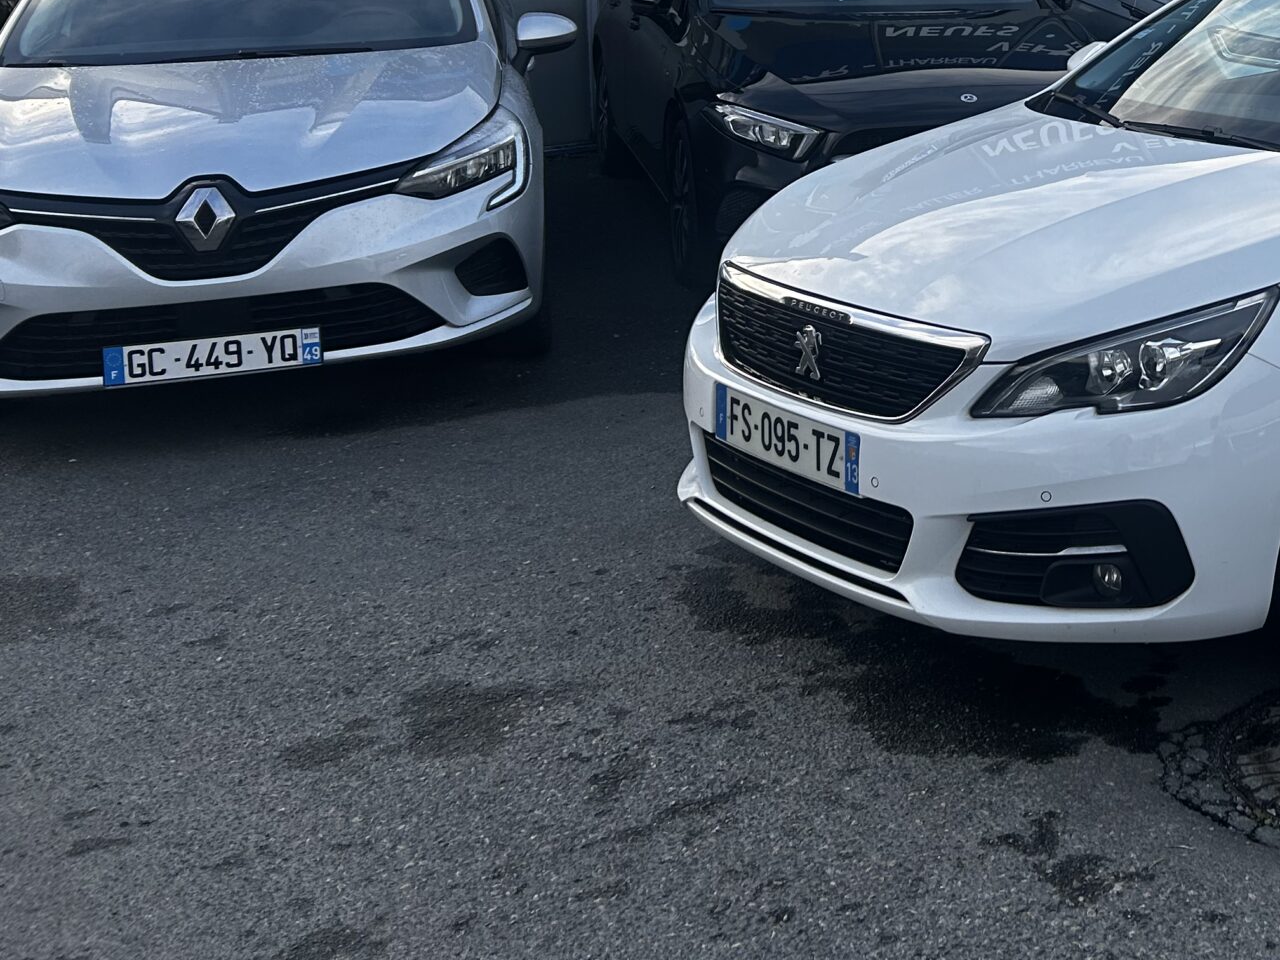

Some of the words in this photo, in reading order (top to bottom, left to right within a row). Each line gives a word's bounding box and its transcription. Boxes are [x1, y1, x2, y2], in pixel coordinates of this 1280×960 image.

[111, 370, 119, 380] F
[126, 333, 299, 379] GC-449-YQ
[303, 346, 321, 360] 49
[729, 395, 841, 479] FS-095-TZ
[846, 462, 858, 484] 13
